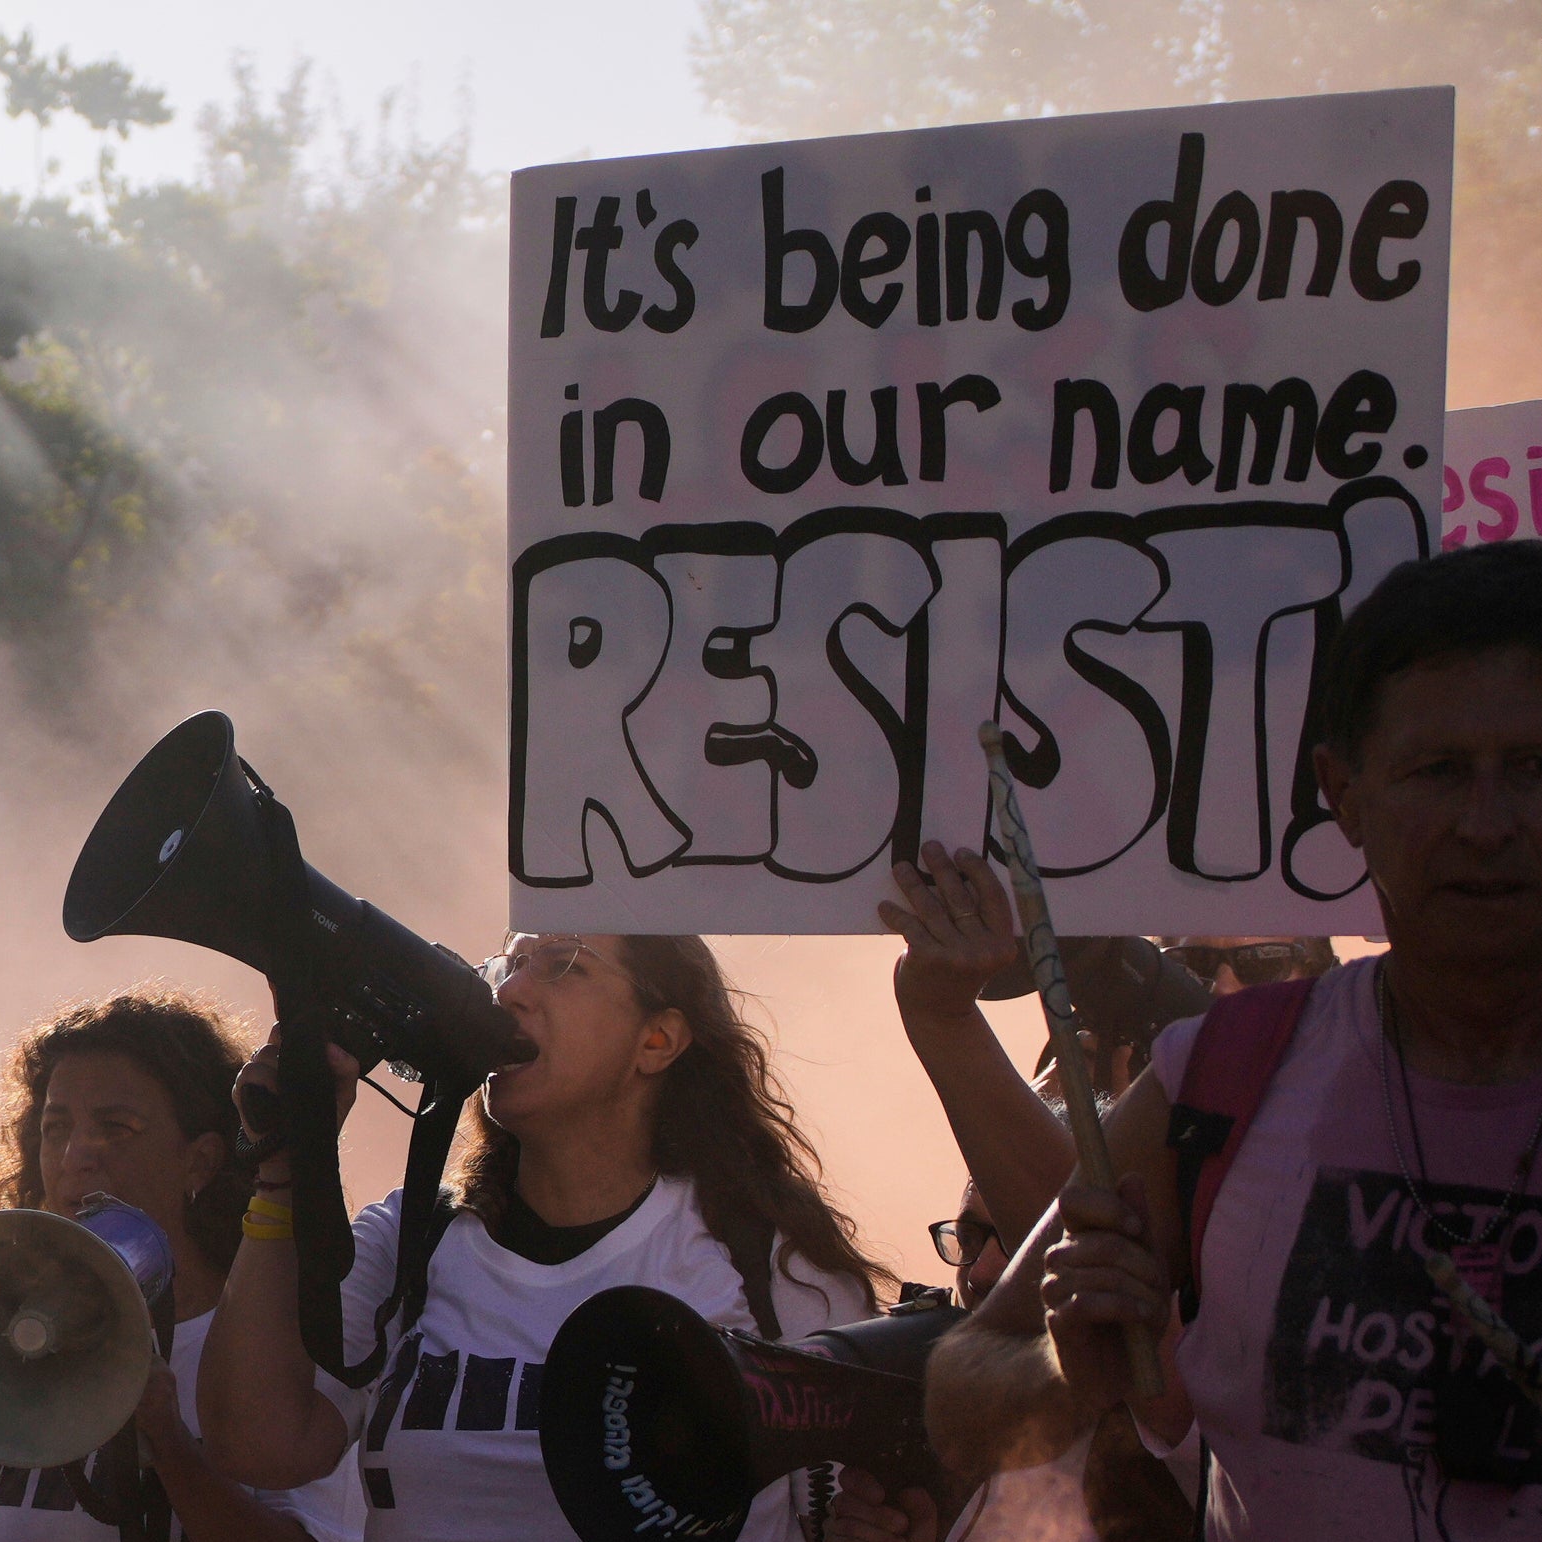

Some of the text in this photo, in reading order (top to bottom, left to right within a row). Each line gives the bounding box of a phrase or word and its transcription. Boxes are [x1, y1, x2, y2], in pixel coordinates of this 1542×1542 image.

[541, 132, 1429, 338] It's being done
[559, 369, 1429, 507] in our name.
[310, 908, 339, 934] TONE
